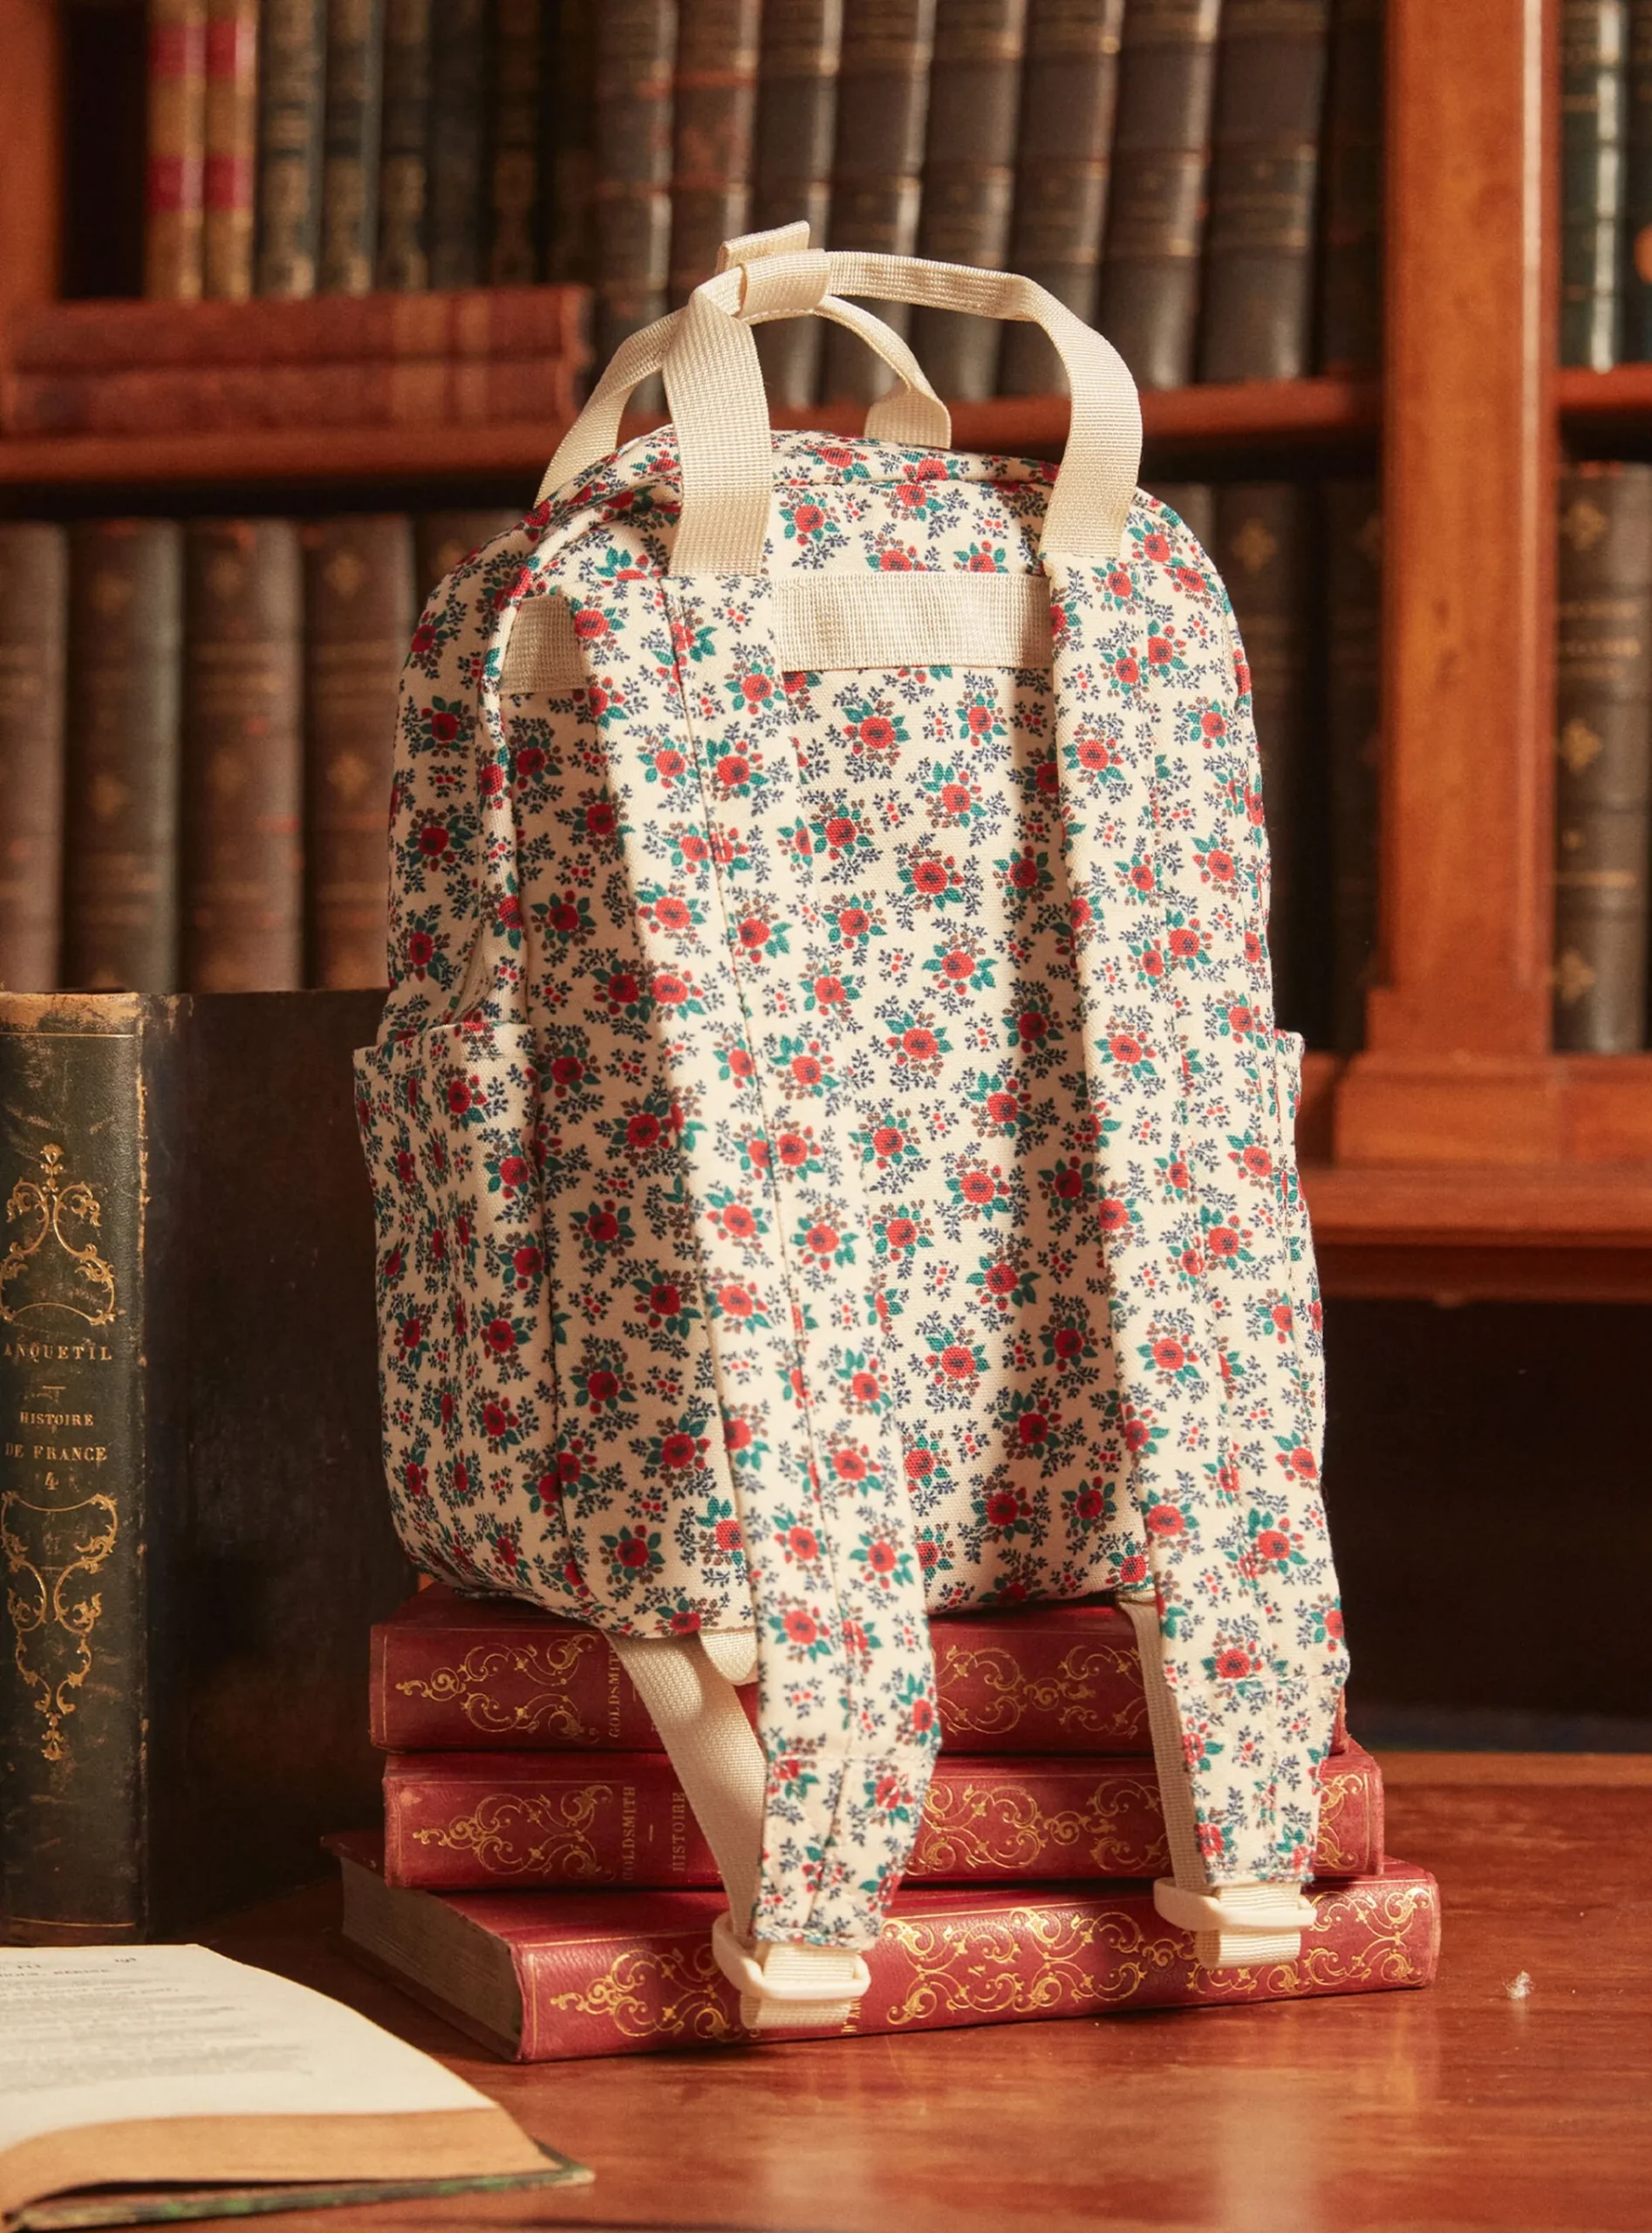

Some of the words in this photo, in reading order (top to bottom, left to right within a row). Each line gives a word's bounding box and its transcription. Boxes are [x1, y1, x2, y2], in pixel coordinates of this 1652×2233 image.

[3, 1342, 113, 1362] ANQUETIL
[19, 1410, 94, 1426] HISTOIRE
[4, 1442, 24, 1458] DE
[33, 1445, 108, 1462] FRANCE
[44, 1471, 59, 1490] 4
[672, 1792, 686, 1872] HISTOIRE
